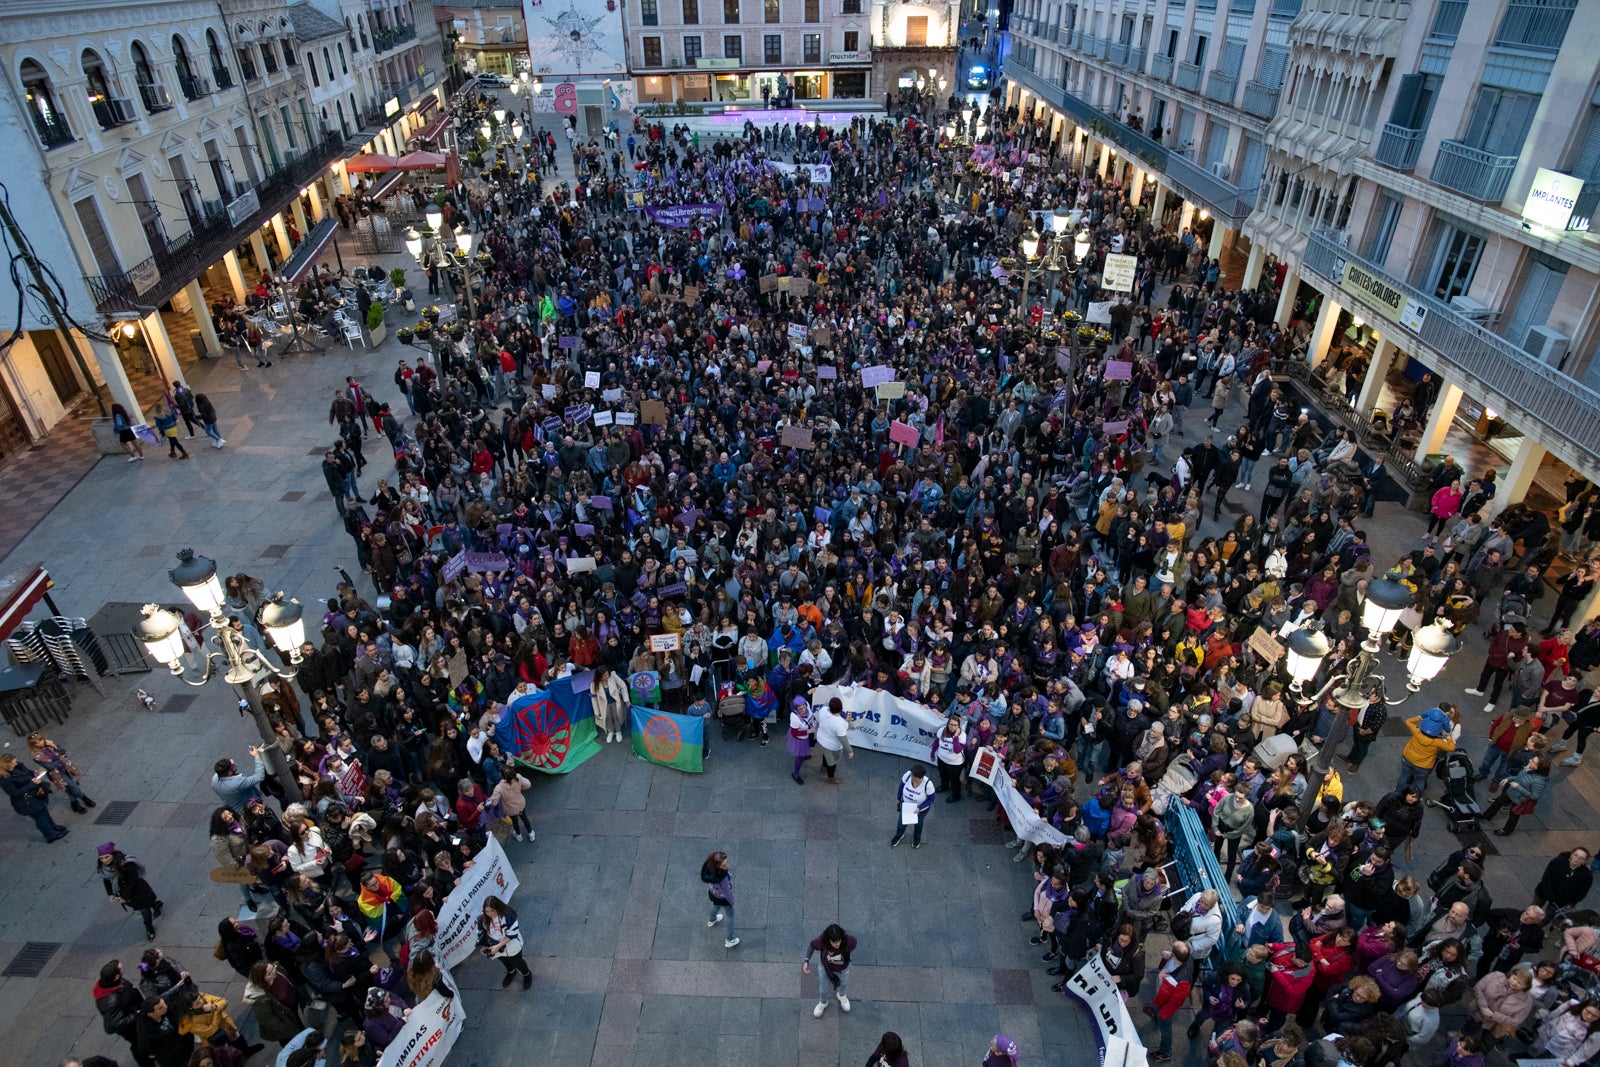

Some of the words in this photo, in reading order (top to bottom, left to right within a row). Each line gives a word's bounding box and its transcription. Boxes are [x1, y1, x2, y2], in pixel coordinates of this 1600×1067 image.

[1531, 188, 1575, 210] IMPLANTES
[891, 714, 908, 728] DE
[438, 913, 461, 940] CAPITAL
[461, 899, 471, 908] EL
[468, 855, 501, 899] PATRIARCADO
[1074, 973, 1099, 996] ni
